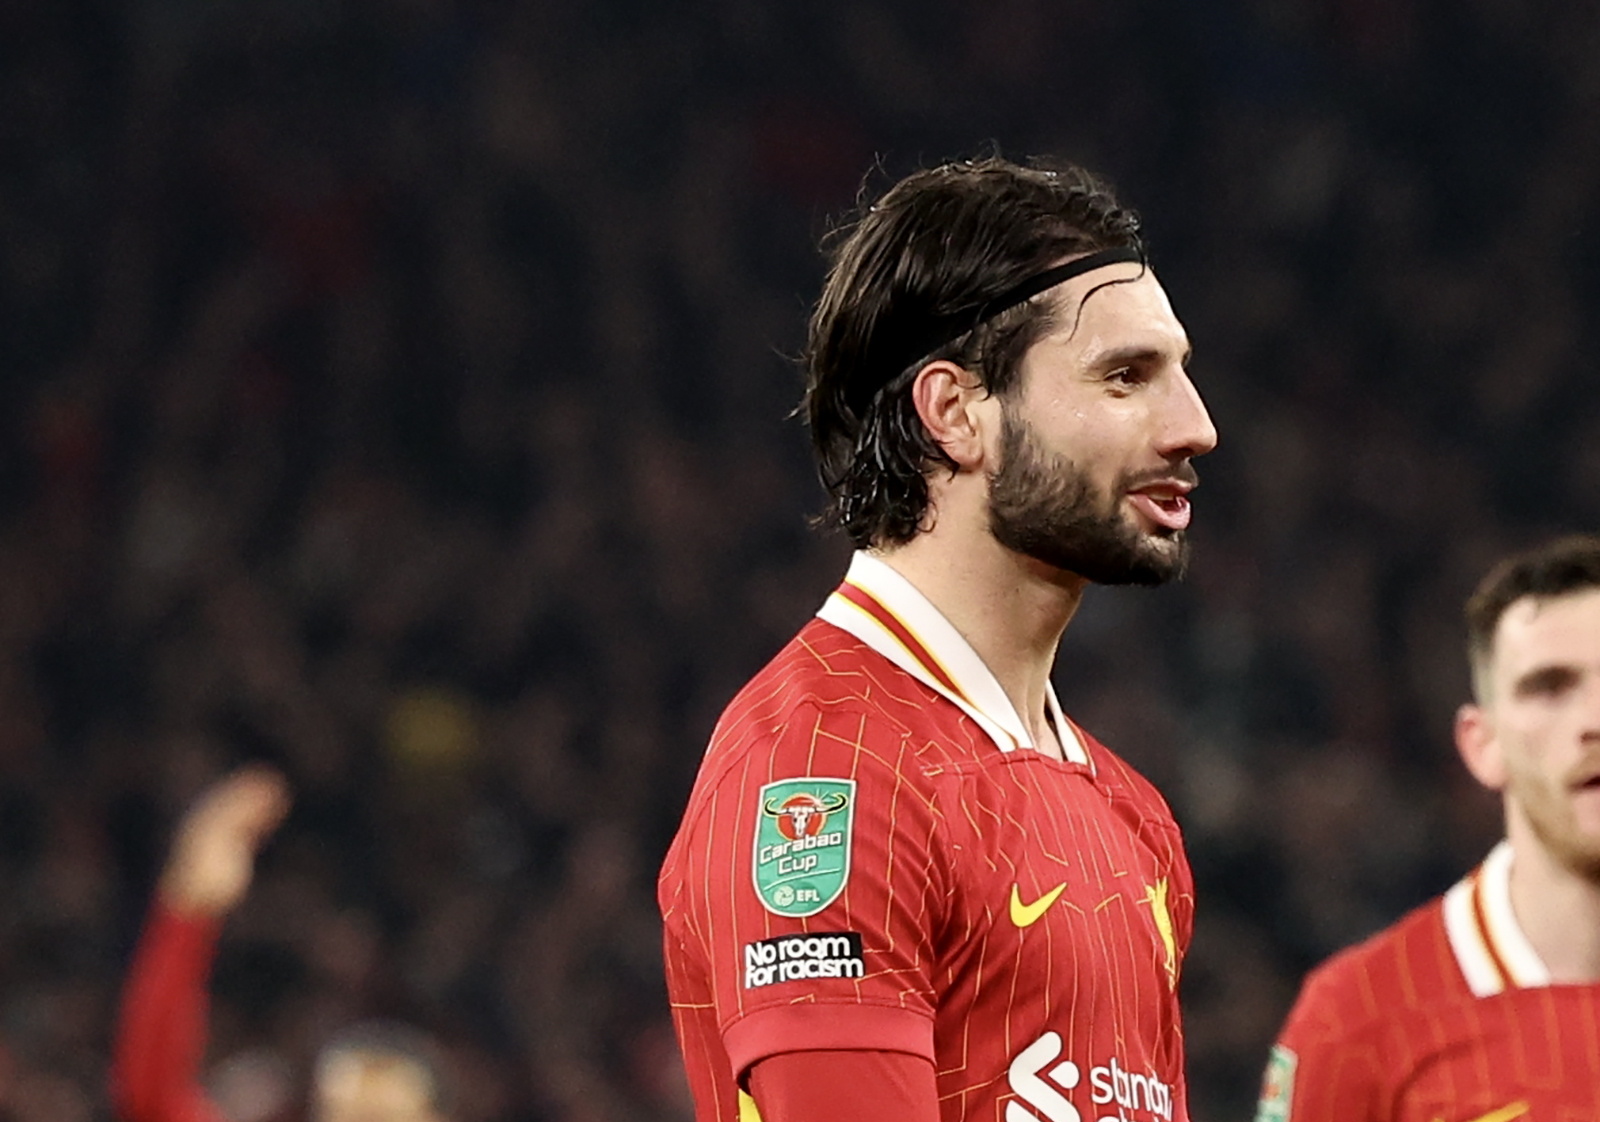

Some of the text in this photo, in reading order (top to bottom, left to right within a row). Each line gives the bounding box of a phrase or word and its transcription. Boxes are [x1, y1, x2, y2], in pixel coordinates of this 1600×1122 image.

[758, 832, 842, 866] Carabao
[778, 854, 818, 875] Cup
[796, 889, 821, 902] EFL
[744, 935, 851, 968] No room
[744, 957, 865, 989] for racism
